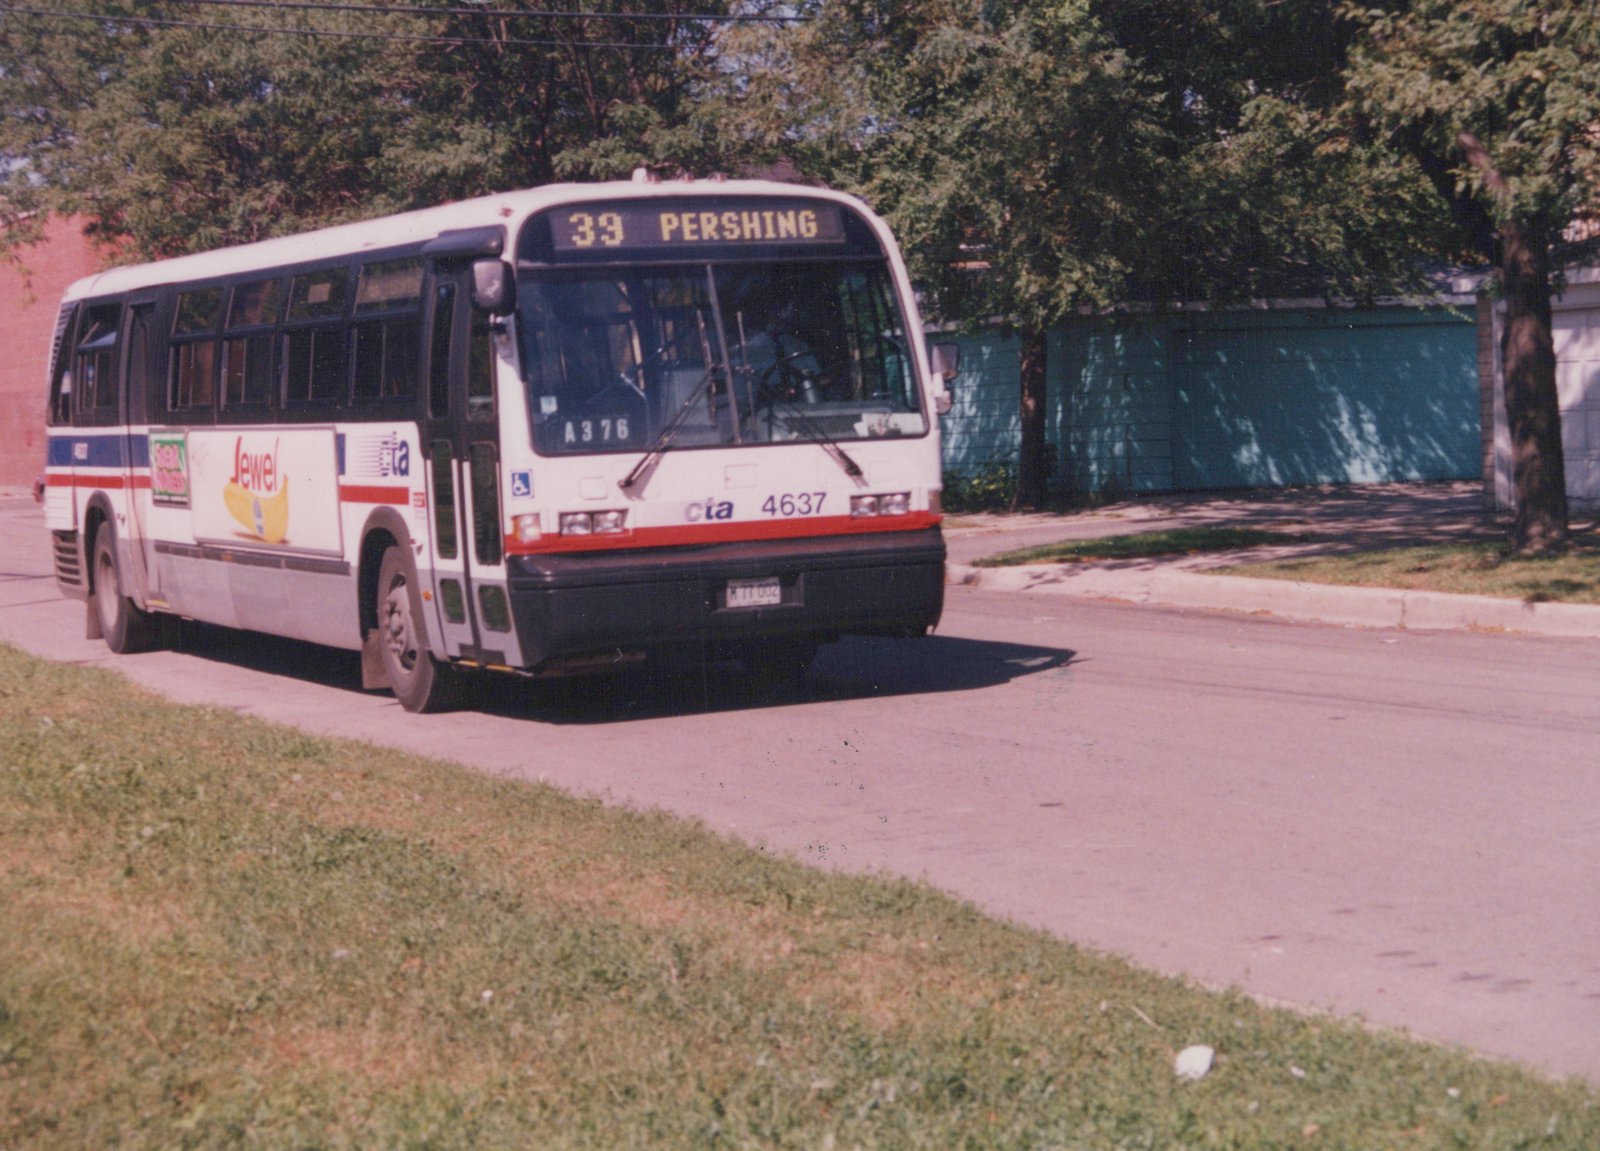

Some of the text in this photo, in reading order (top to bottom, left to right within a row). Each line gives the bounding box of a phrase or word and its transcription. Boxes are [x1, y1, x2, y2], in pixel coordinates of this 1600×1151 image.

[659, 209, 818, 241] PERSHING
[564, 418, 629, 443] A376
[230, 435, 280, 492] Jewel
[684, 492, 827, 522] cta 4637
